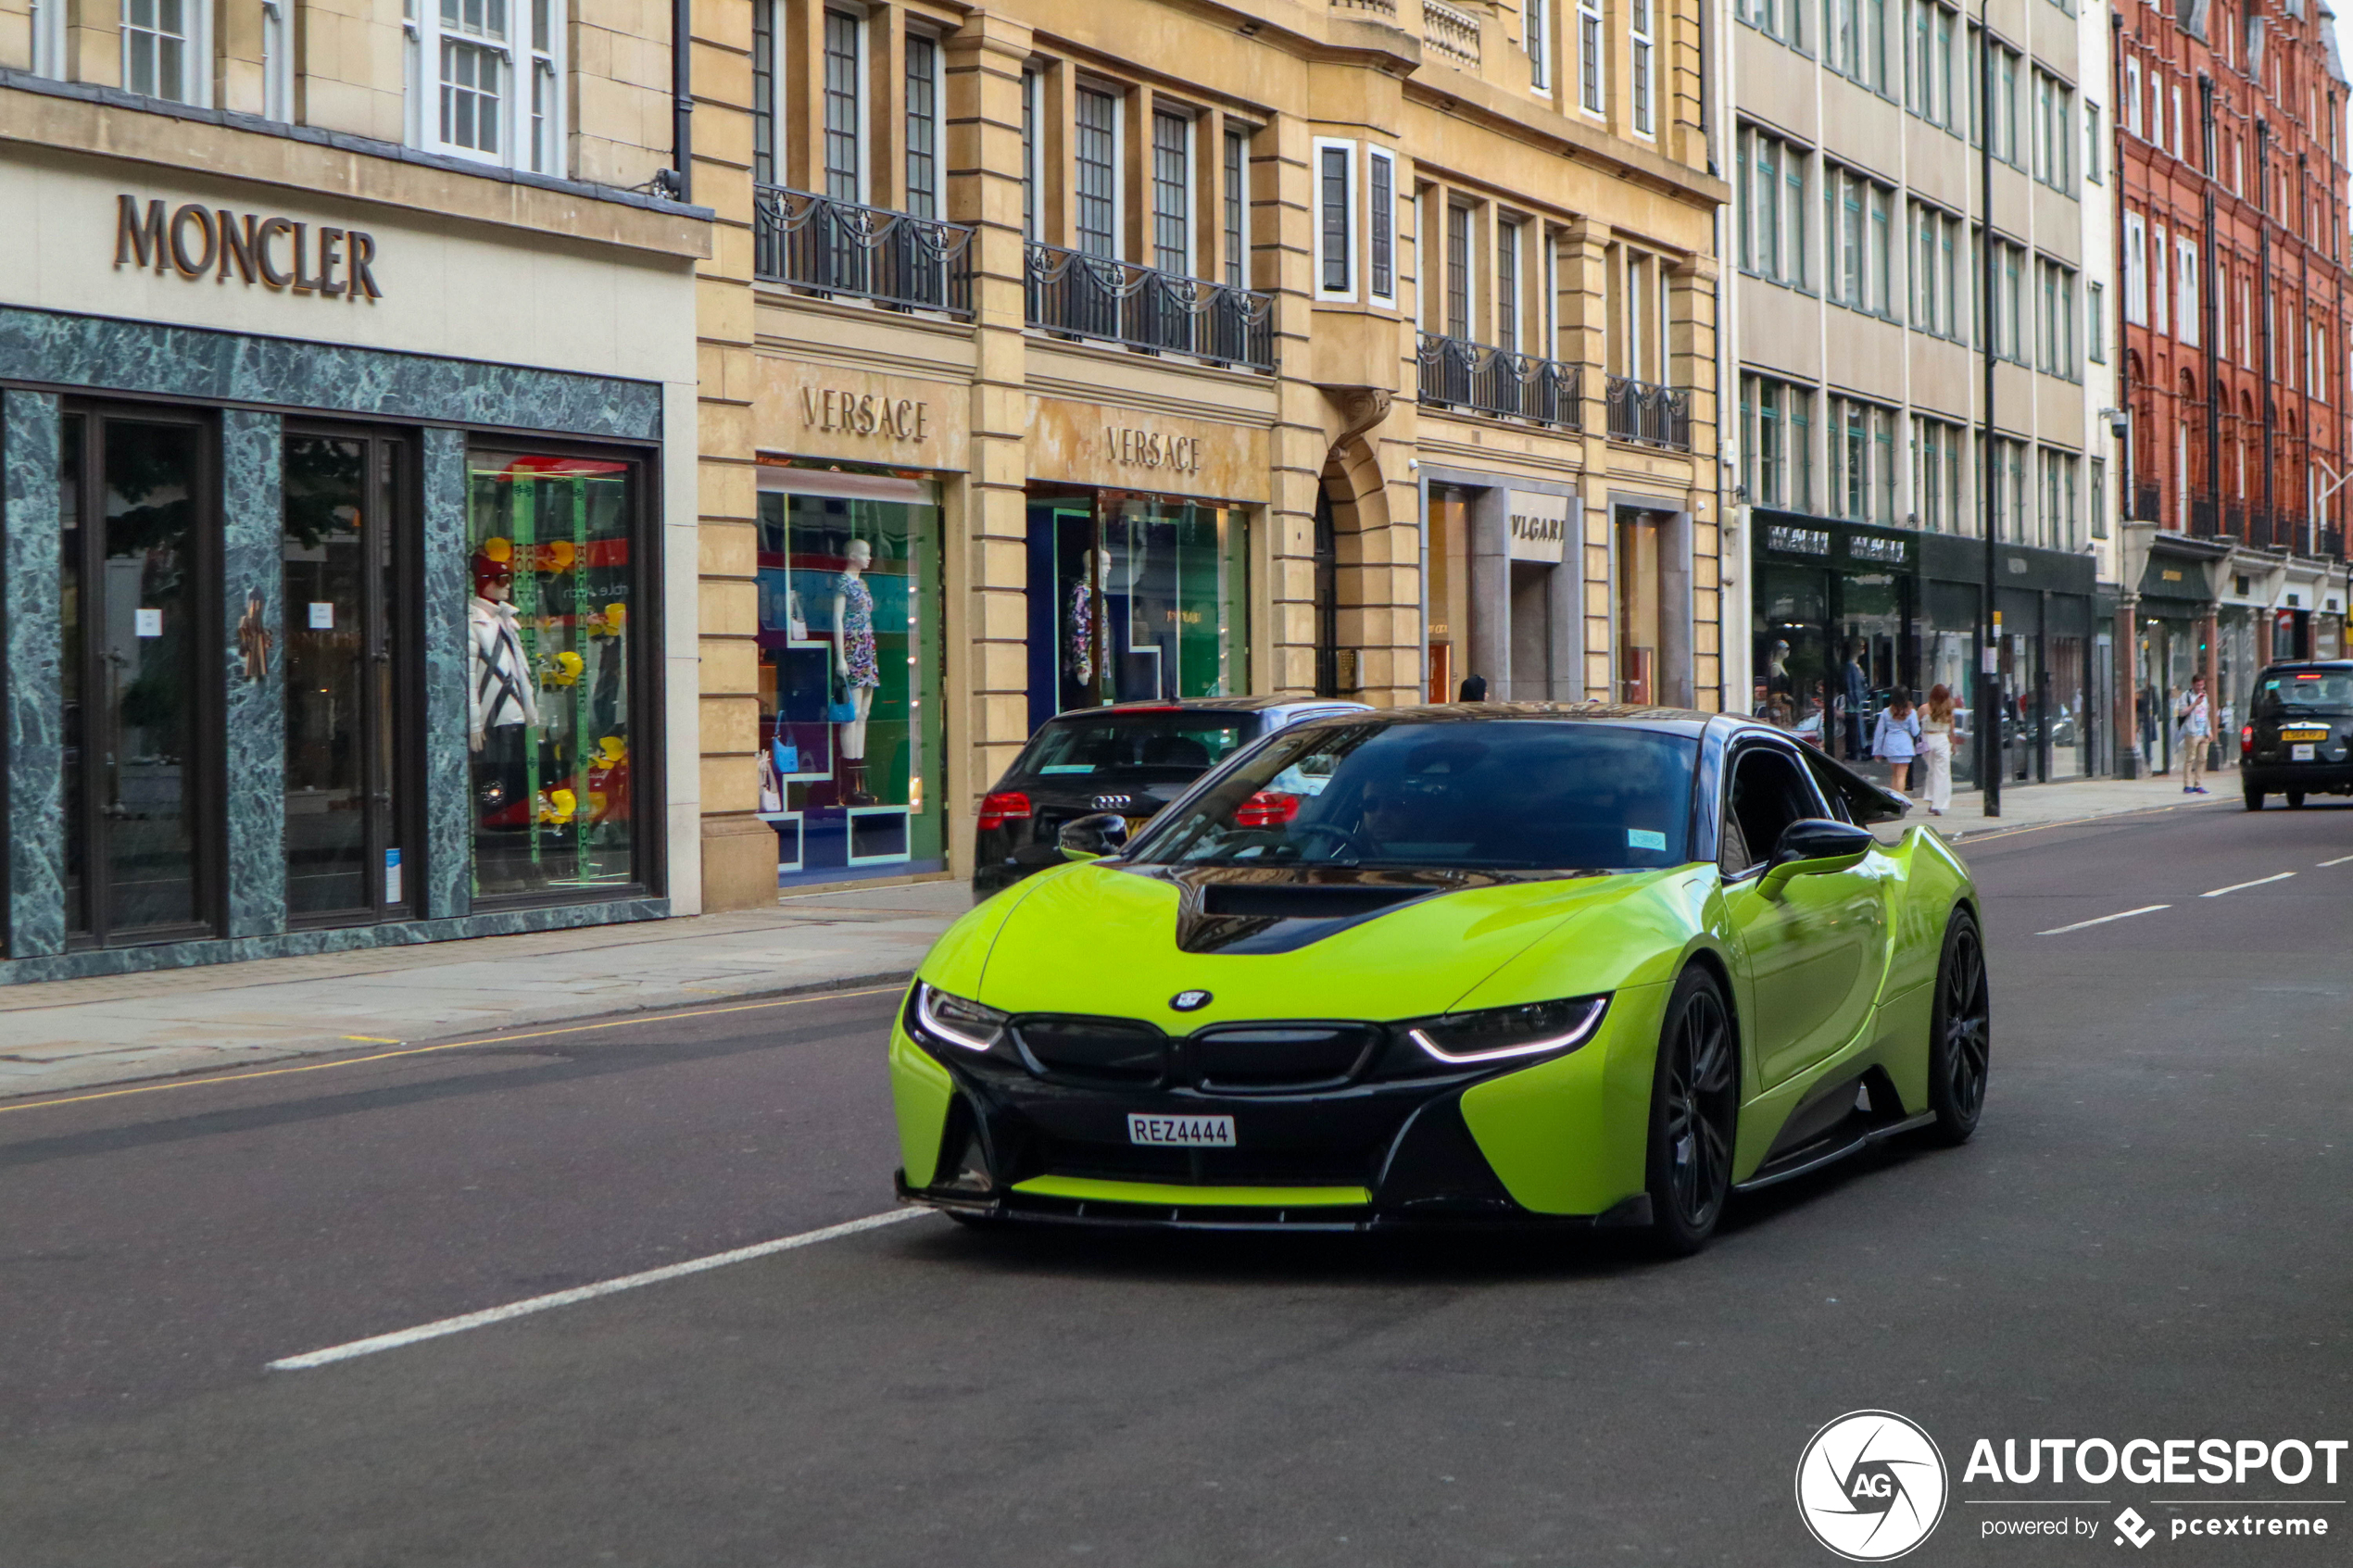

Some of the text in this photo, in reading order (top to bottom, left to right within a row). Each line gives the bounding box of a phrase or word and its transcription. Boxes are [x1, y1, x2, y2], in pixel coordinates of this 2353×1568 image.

[114, 194, 384, 302] MONCLER
[799, 385, 928, 441] VERSACE
[1105, 426, 1201, 471] VERSACE
[1133, 1119, 1228, 1143] REZ4444
